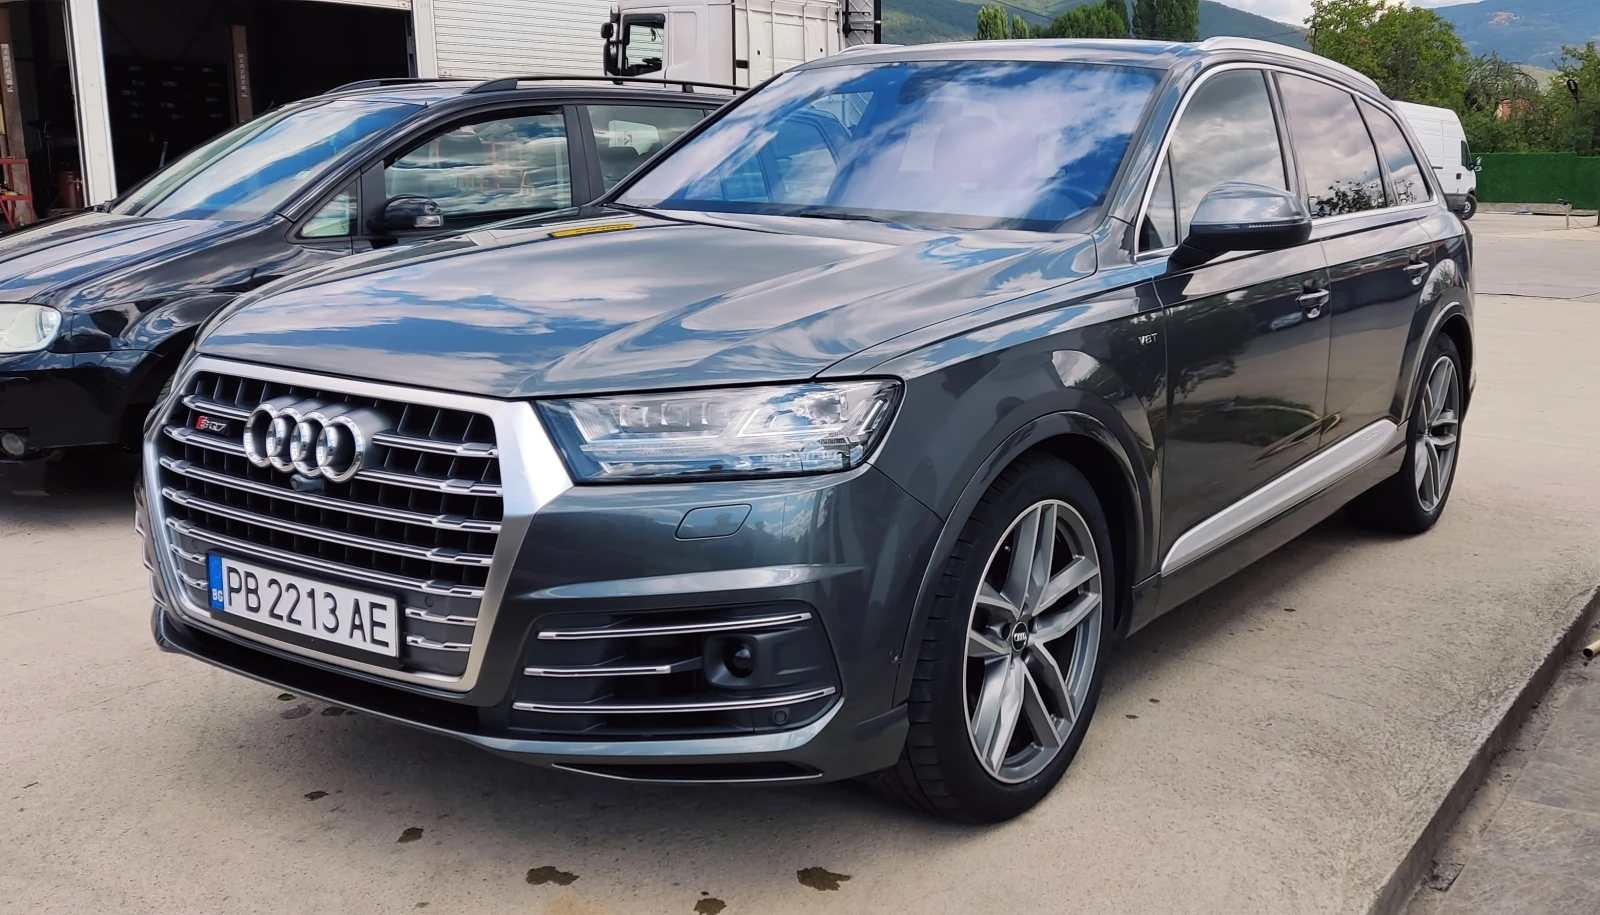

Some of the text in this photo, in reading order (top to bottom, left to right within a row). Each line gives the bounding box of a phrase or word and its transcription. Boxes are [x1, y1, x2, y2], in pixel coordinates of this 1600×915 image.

[1138, 332, 1158, 345] V8T
[212, 588, 223, 602] BG
[226, 565, 390, 648] PB 2213 AE
